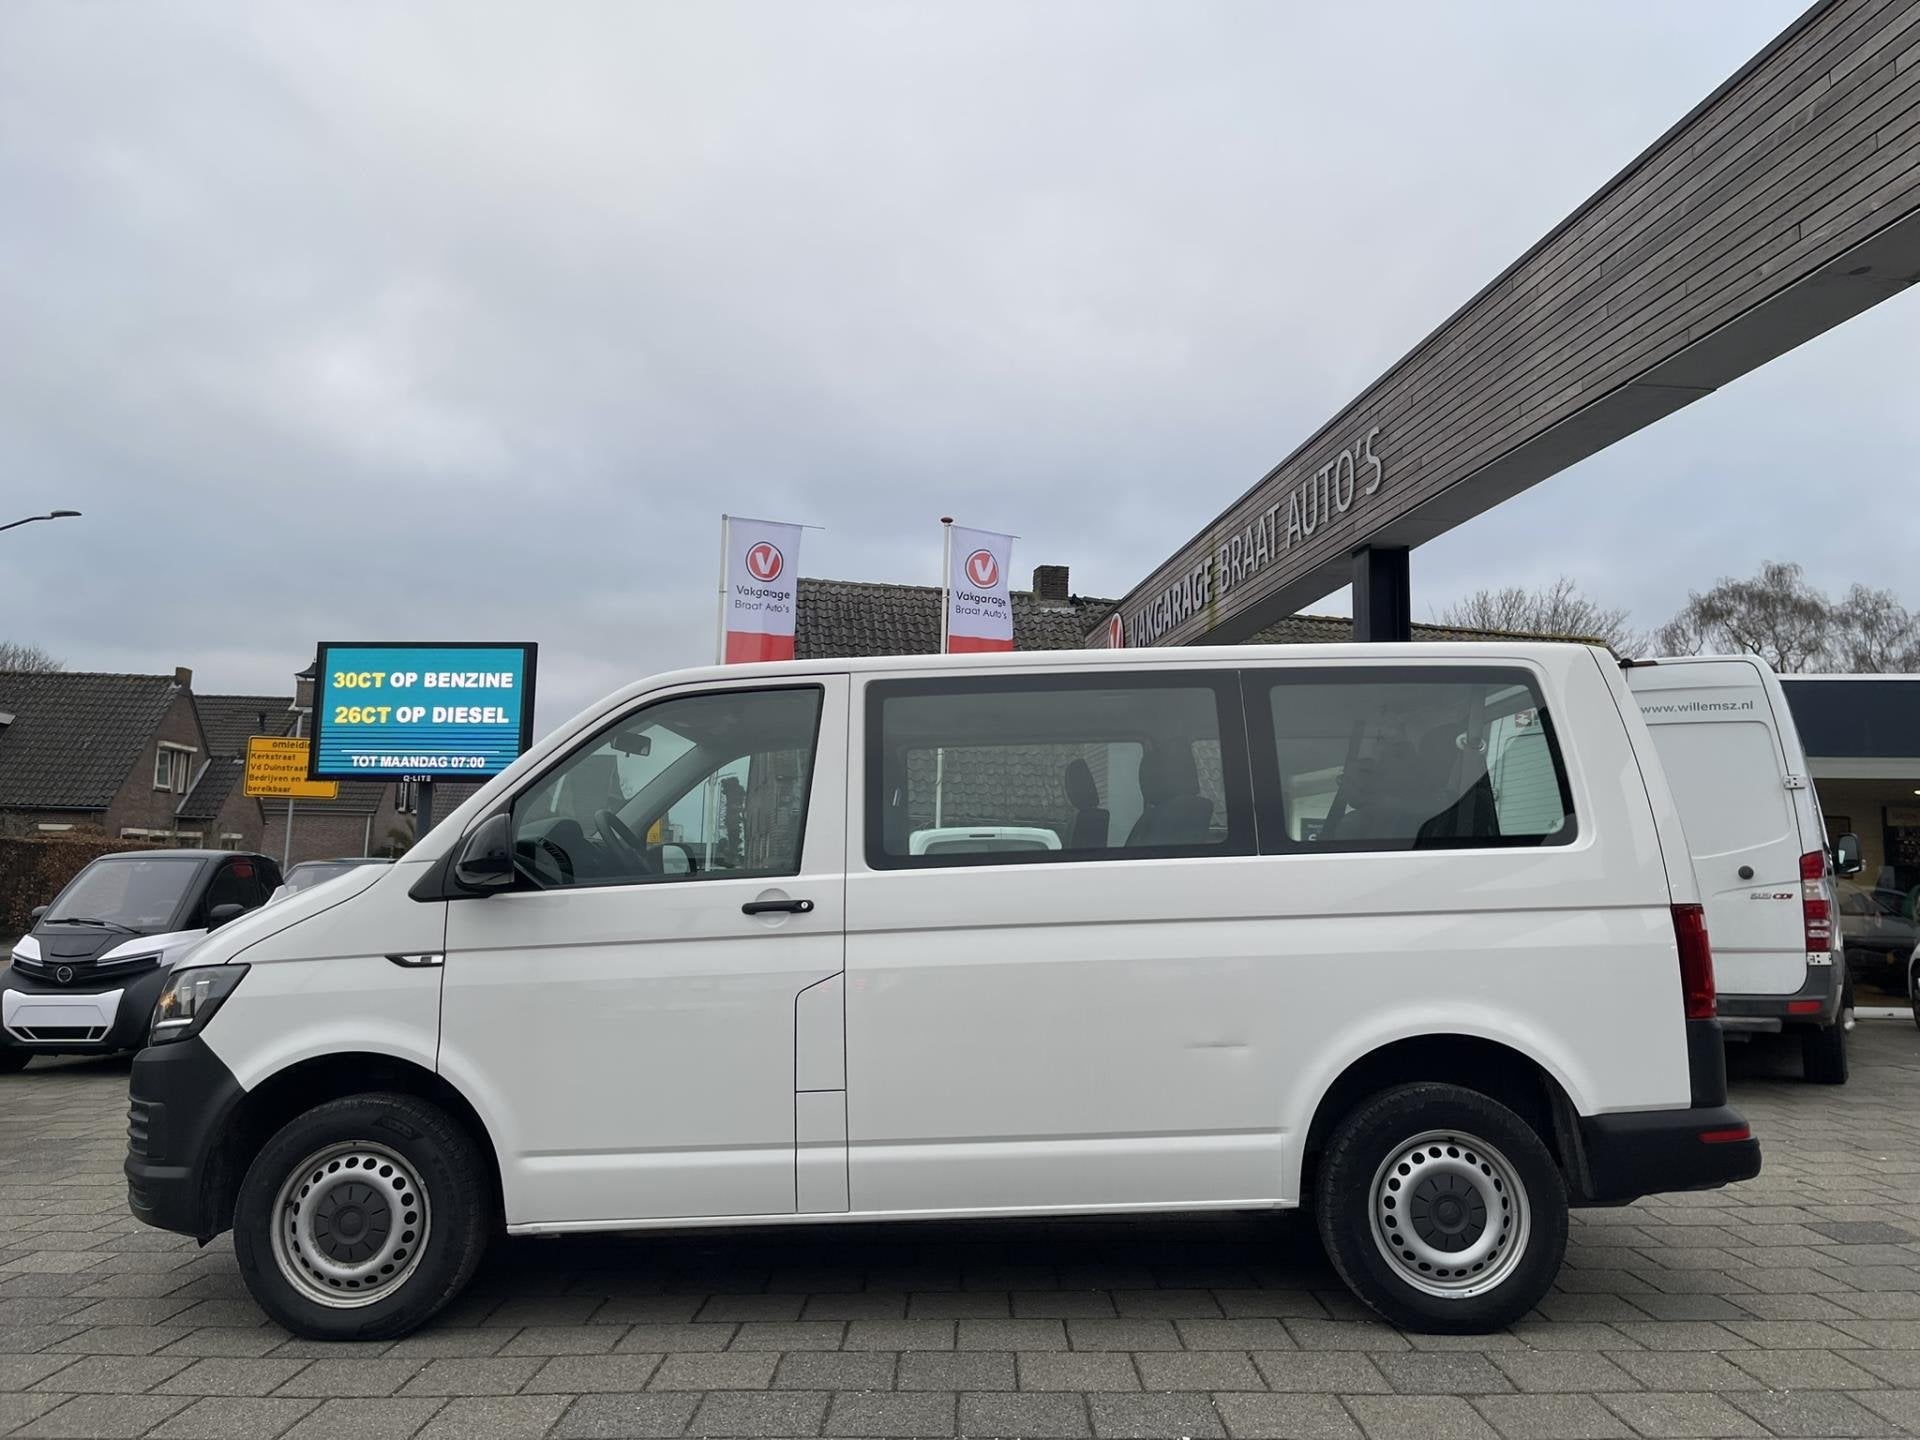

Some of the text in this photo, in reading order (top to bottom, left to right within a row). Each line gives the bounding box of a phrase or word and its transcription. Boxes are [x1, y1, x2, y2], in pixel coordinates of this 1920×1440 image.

[1131, 556, 1213, 648] VAKGARAGE
[1219, 503, 1280, 594] BRAAT
[1286, 427, 1383, 549] AUTO'S
[736, 585, 790, 601] Vakgarage
[956, 591, 1006, 607] Vakgarage
[735, 600, 762, 610] Braat
[955, 605, 1007, 620] Braat Auto's
[333, 672, 514, 688] 30CT OP BENZINE
[1640, 700, 1754, 714] www.willemsz.nl
[334, 706, 510, 724] 26CT OP DIESEL
[272, 741, 310, 749] omleidi
[251, 753, 296, 761] Kerkstraat
[351, 756, 485, 768] TOT MAANDAG 07:00
[249, 774, 288, 783] Bedrijven
